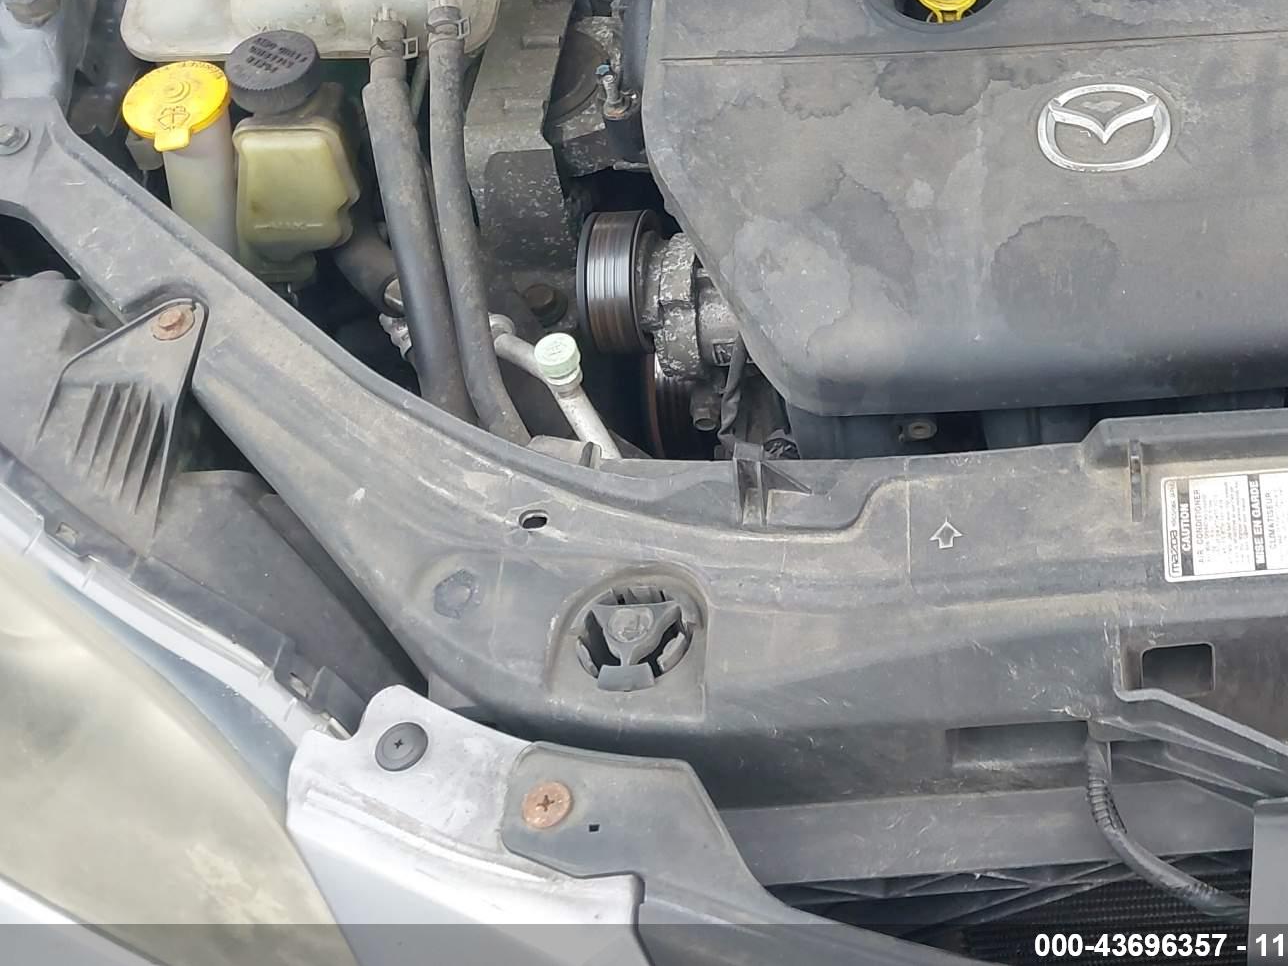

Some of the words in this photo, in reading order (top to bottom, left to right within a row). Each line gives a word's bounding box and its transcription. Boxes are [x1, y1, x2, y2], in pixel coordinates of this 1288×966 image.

[1193, 489, 1204, 545] CONDITIONER
[1248, 480, 1261, 518] GARDE
[1179, 502, 1192, 552] CAUTION
[1252, 519, 1263, 536] EN
[1253, 536, 1265, 564] MISE
